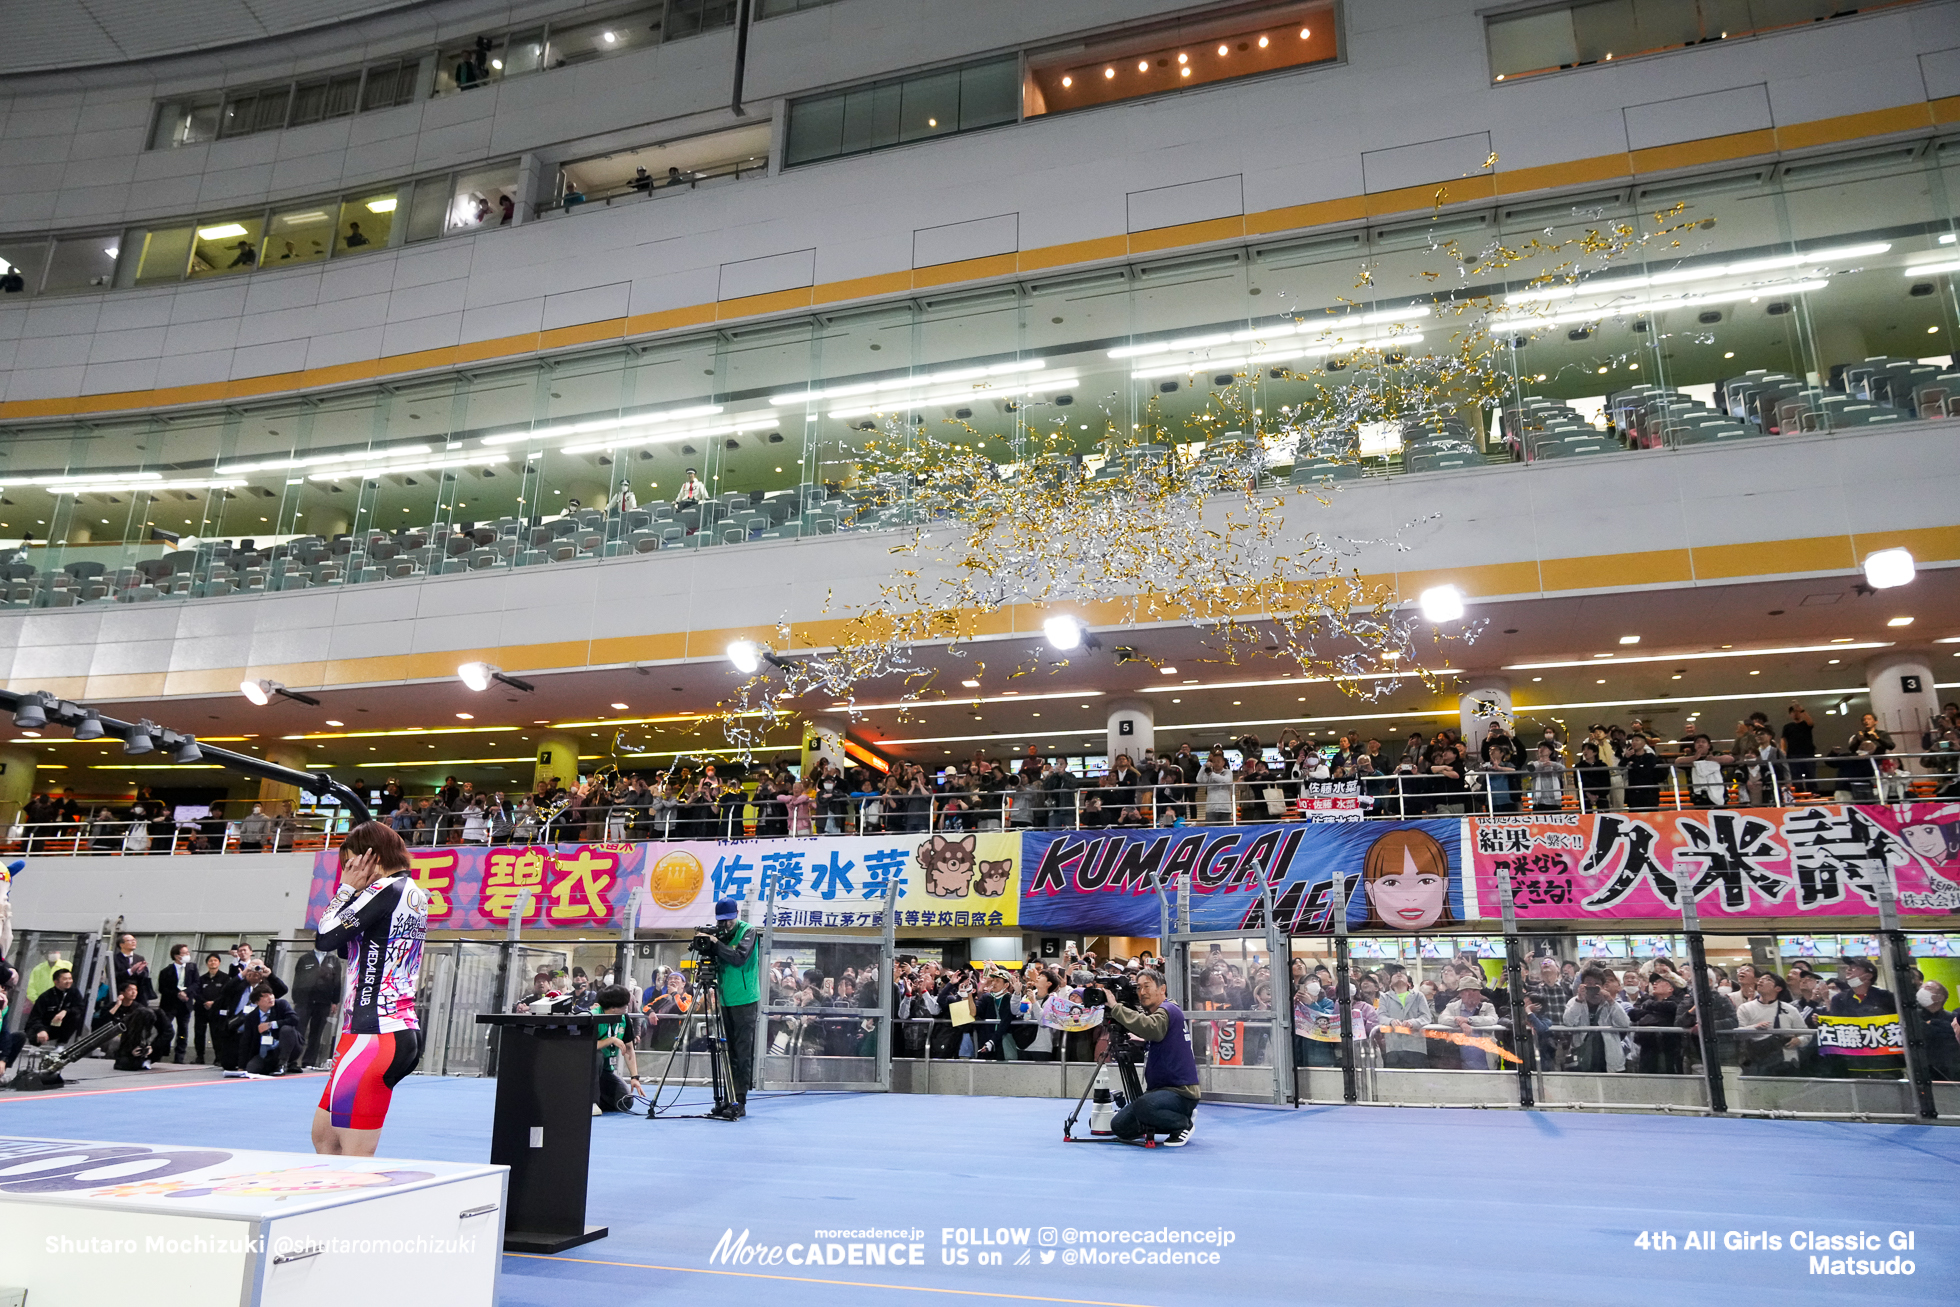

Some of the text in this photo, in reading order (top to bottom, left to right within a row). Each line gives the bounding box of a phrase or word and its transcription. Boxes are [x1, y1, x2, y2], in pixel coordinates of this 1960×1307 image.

[1906, 678, 1917, 689] 3
[1122, 723, 1130, 732] 5
[811, 739, 818, 748] 6
[543, 754, 549, 762] 7
[1309, 780, 1358, 794] 佐藤水菜
[1030, 828, 1307, 893] KUMAGAI
[710, 848, 910, 902] 佐藤水菜
[1240, 873, 1362, 935] MEI
[642, 944, 650, 955] 6
[1045, 942, 1054, 954] 5
[1540, 938, 1551, 951] 4
[360, 939, 380, 1007] MEDALIST CLUB
[1817, 1023, 1903, 1049] 佐藤水菜
